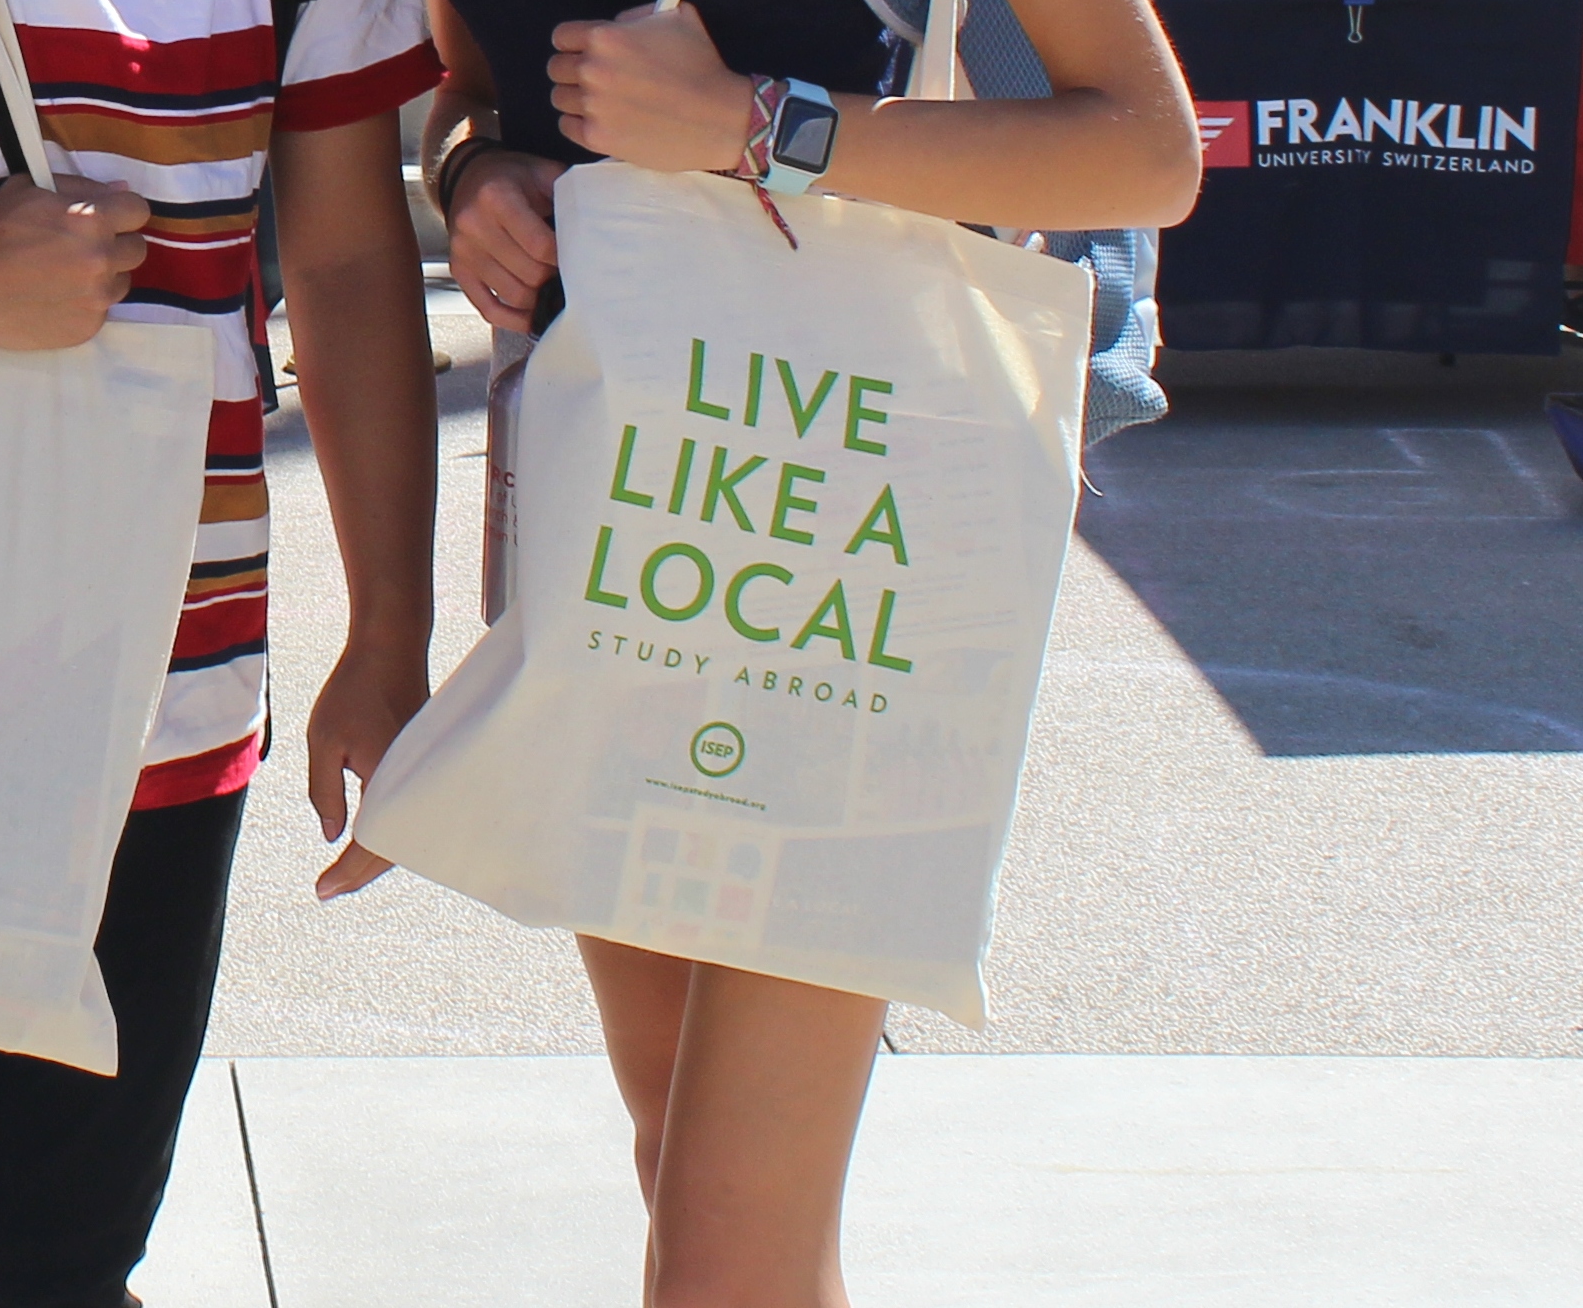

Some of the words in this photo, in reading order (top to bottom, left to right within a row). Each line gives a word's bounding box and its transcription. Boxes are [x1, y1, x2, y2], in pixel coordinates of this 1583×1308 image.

[1257, 98, 1535, 150] FRANKLIN
[1258, 149, 1371, 168] UNIVERSITY
[1382, 152, 1535, 174] SWITZERLAND
[685, 339, 891, 454] LIVE
[610, 424, 823, 544] LIKE
[844, 485, 906, 564] A
[585, 525, 911, 673] LOCAL
[587, 629, 709, 673] STUDY
[734, 666, 885, 712] ABROAD
[700, 740, 734, 758] ISEP
